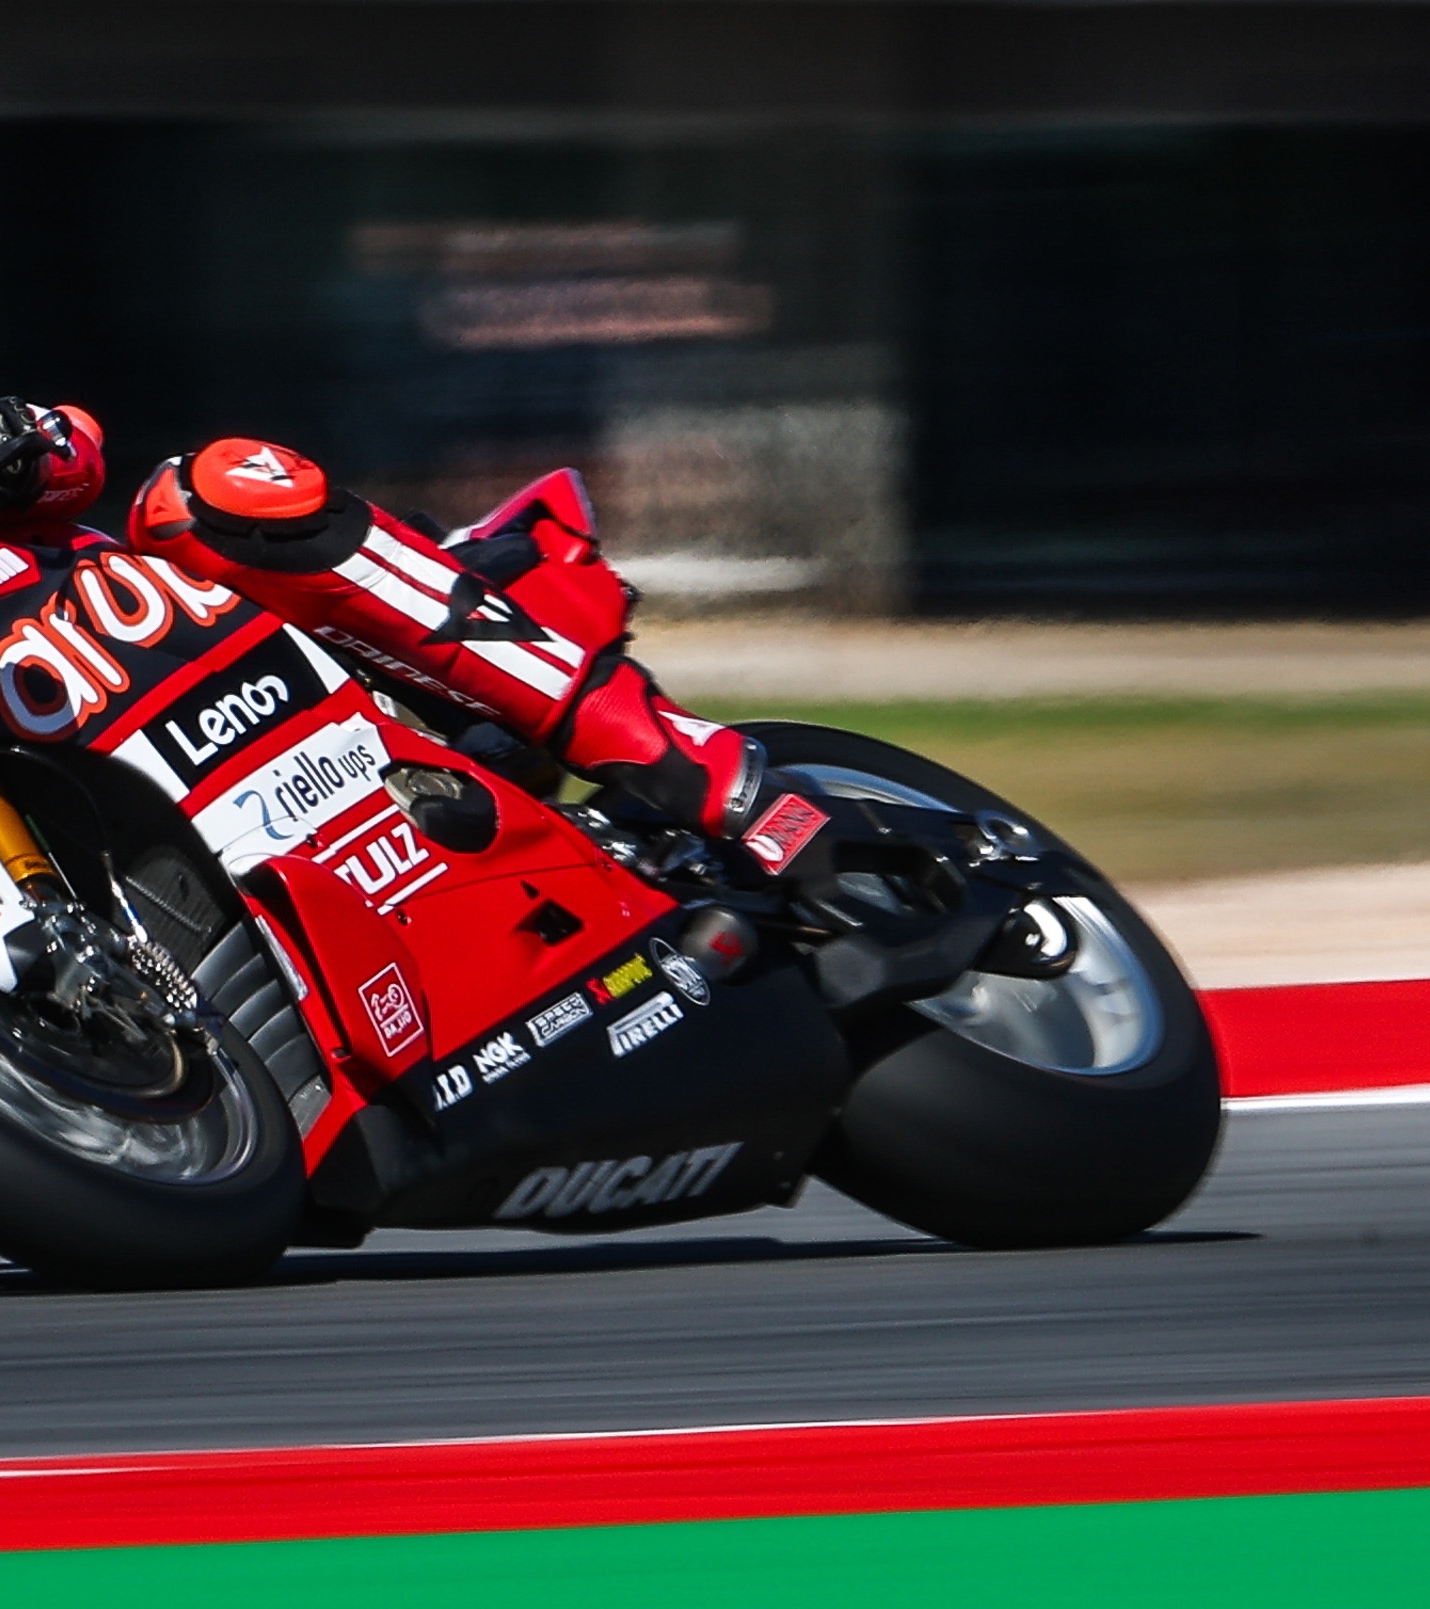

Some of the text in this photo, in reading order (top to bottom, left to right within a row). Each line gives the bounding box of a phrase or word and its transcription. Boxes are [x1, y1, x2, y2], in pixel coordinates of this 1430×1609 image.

[273, 744, 377, 822] riello ups
[334, 822, 430, 895] TULZ
[472, 1031, 524, 1074] NGK
[606, 991, 685, 1058] PIRELLI
[493, 1141, 745, 1220] DUCATI
